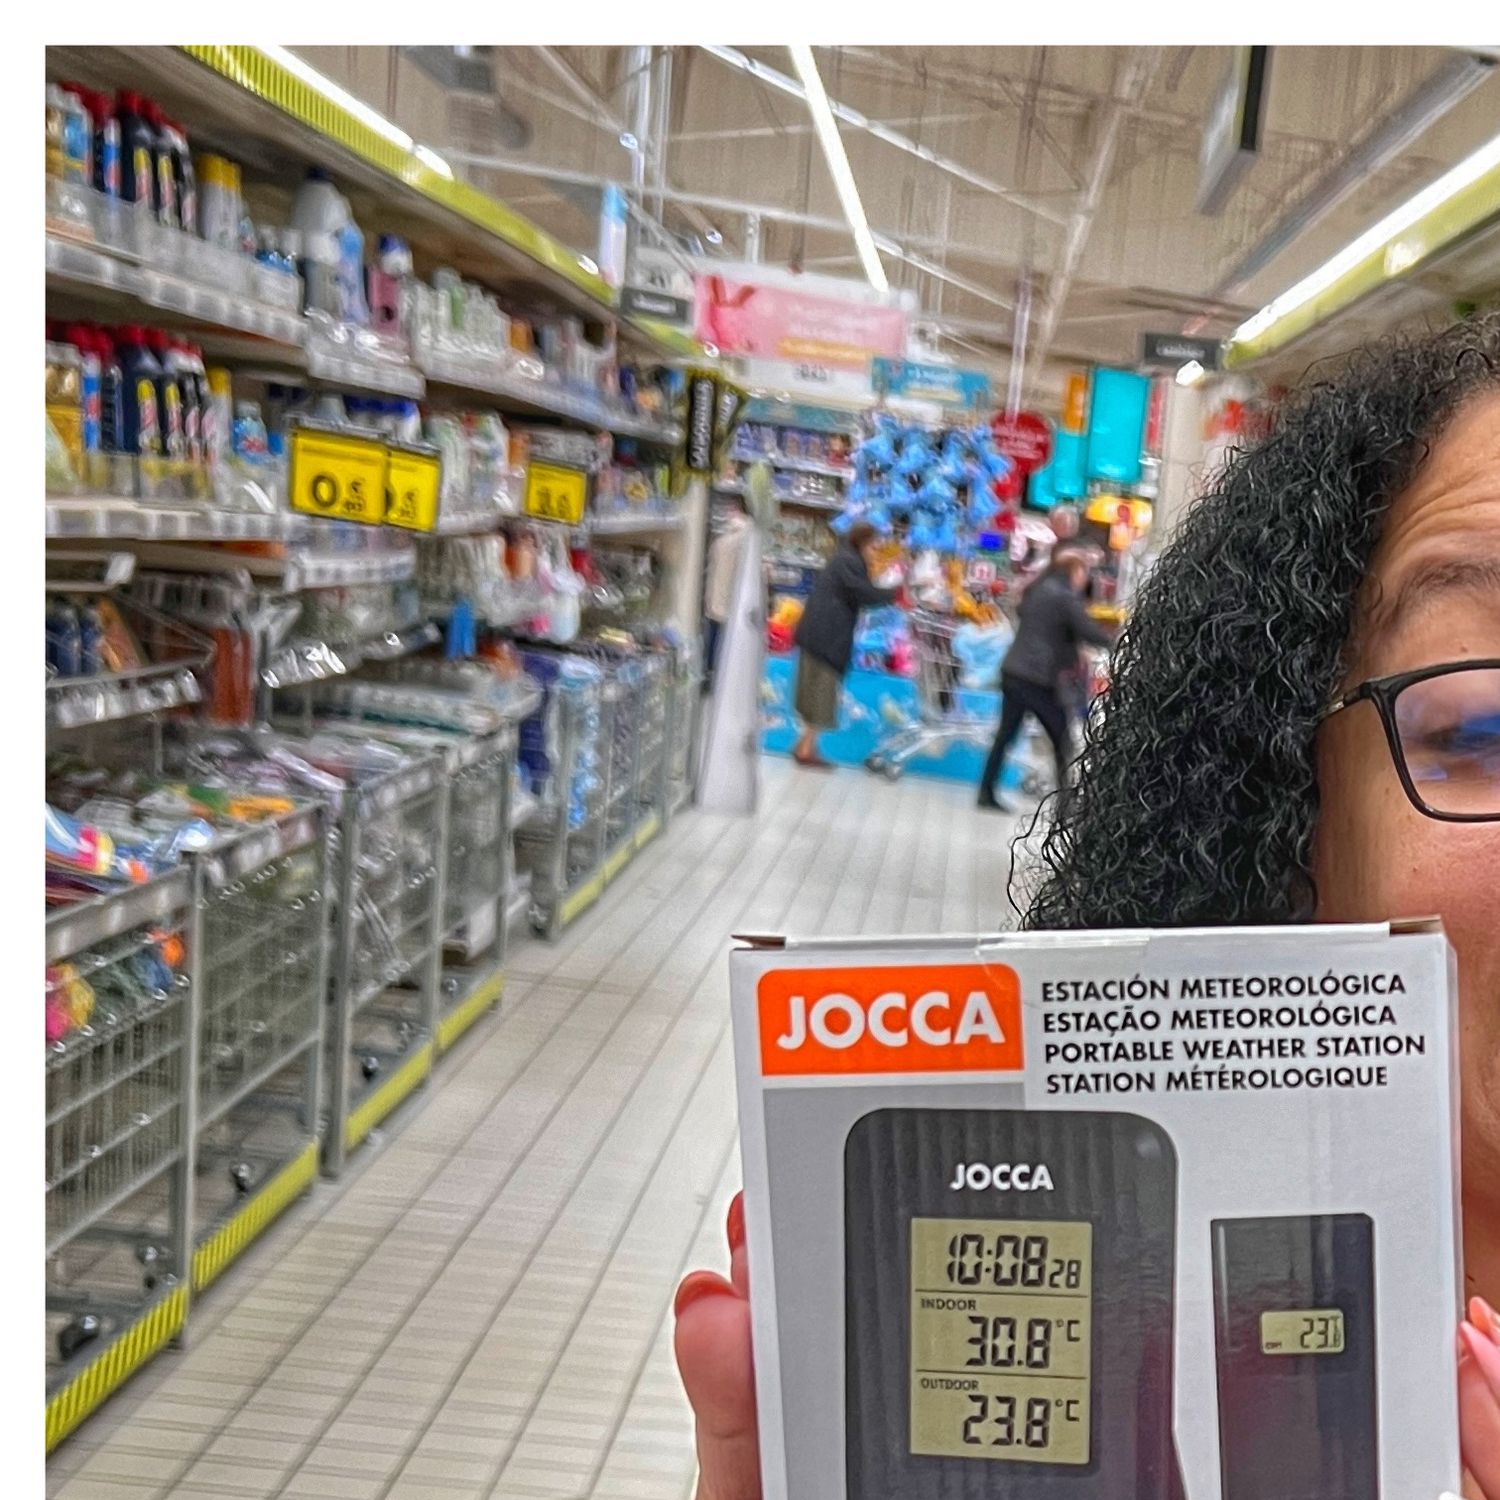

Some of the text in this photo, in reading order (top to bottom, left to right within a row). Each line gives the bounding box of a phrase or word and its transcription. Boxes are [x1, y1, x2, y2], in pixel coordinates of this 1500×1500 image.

[1042, 970, 1406, 1002] ESTACIÓN METEOROLÓGICA
[777, 991, 1006, 1050] JOCCA
[1043, 1001, 1397, 1036] ESTAÇÃO METEOROLÓGICA
[1045, 1035, 1425, 1063] PORTABLE WEATHER STATION
[1047, 1064, 1387, 1094] STATION MÉTÉROLOGIQUE
[950, 1162, 1054, 1191] JOCCA
[947, 1234, 1082, 1289] 10:08 28
[921, 1298, 976, 1311] INDOOR
[965, 1315, 1052, 1369] 30.8
[921, 1378, 979, 1391] OUTDOOR
[963, 1395, 1051, 1448] 23.8
